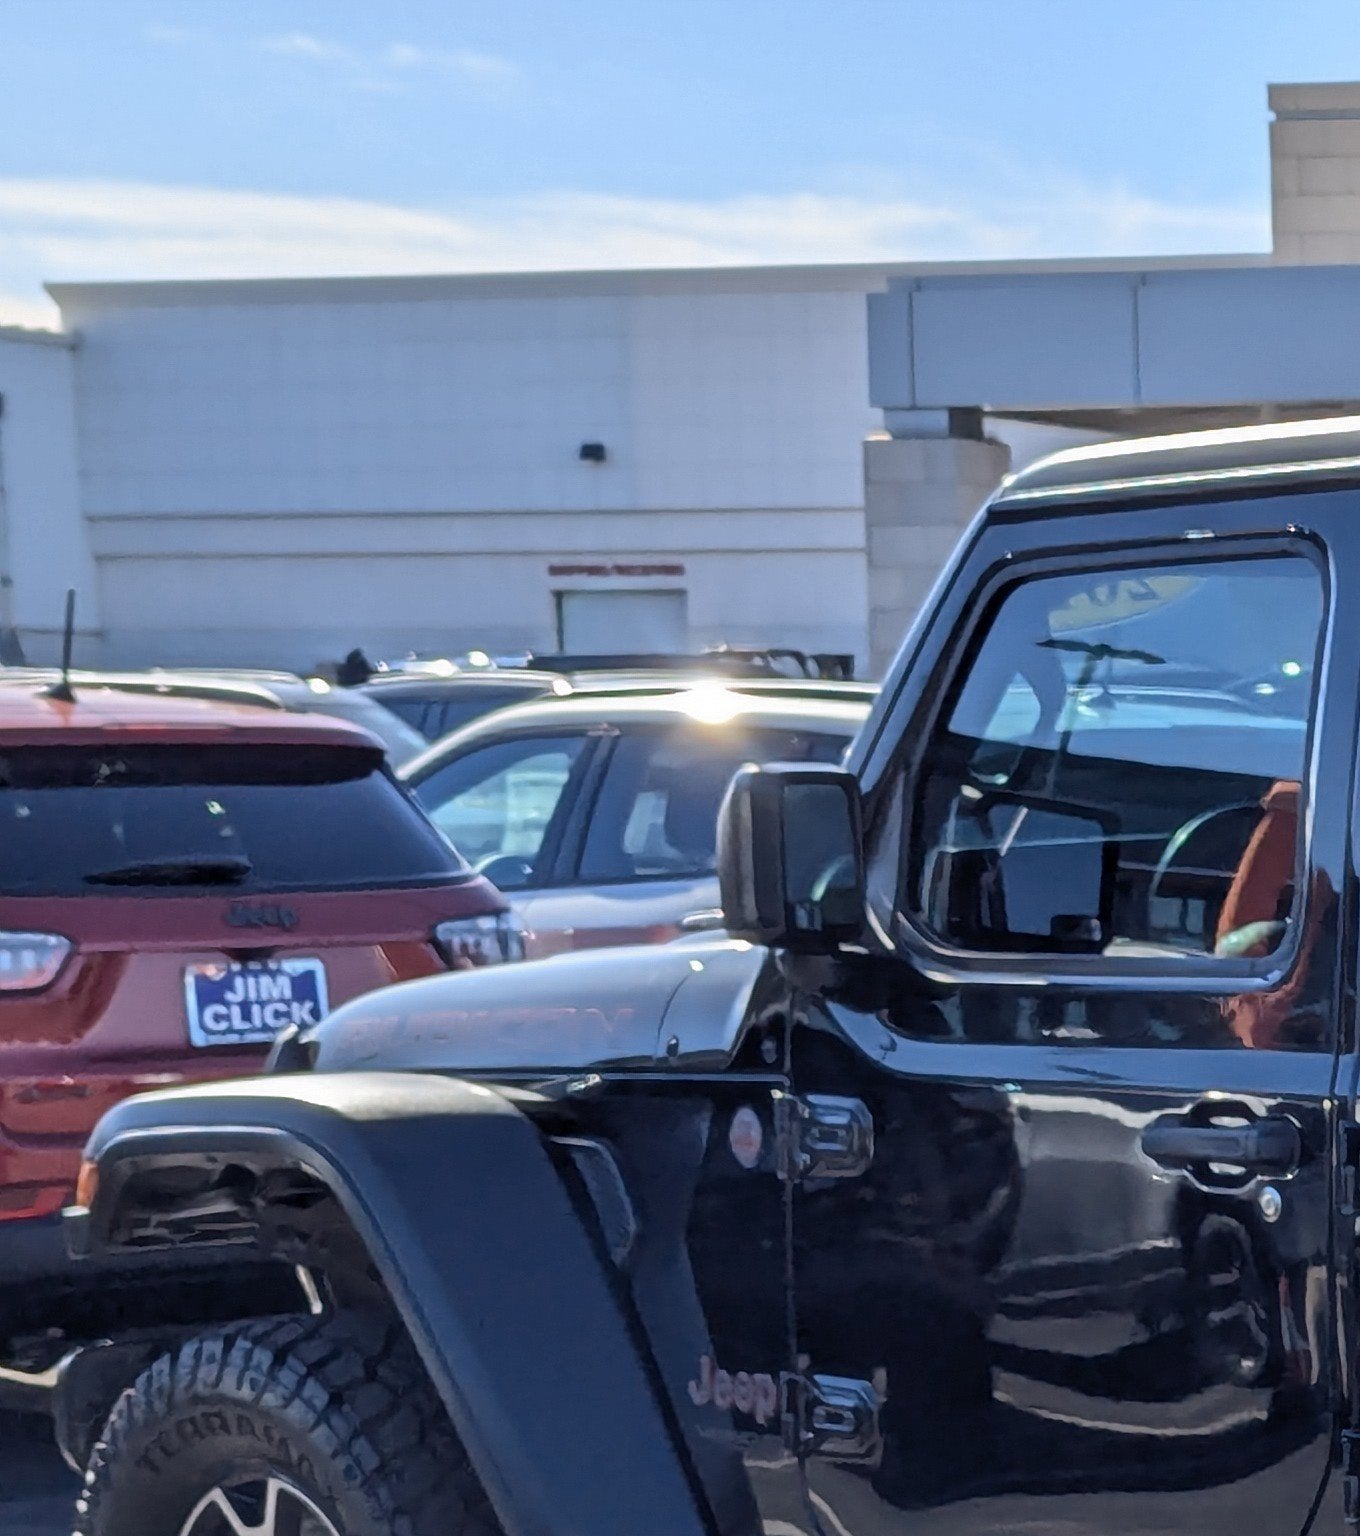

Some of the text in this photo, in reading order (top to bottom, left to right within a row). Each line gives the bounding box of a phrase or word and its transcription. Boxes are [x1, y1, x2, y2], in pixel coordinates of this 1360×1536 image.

[224, 975, 292, 1003] JIM
[202, 1001, 316, 1031] CLICK
[688, 1354, 778, 1427] Jeep
